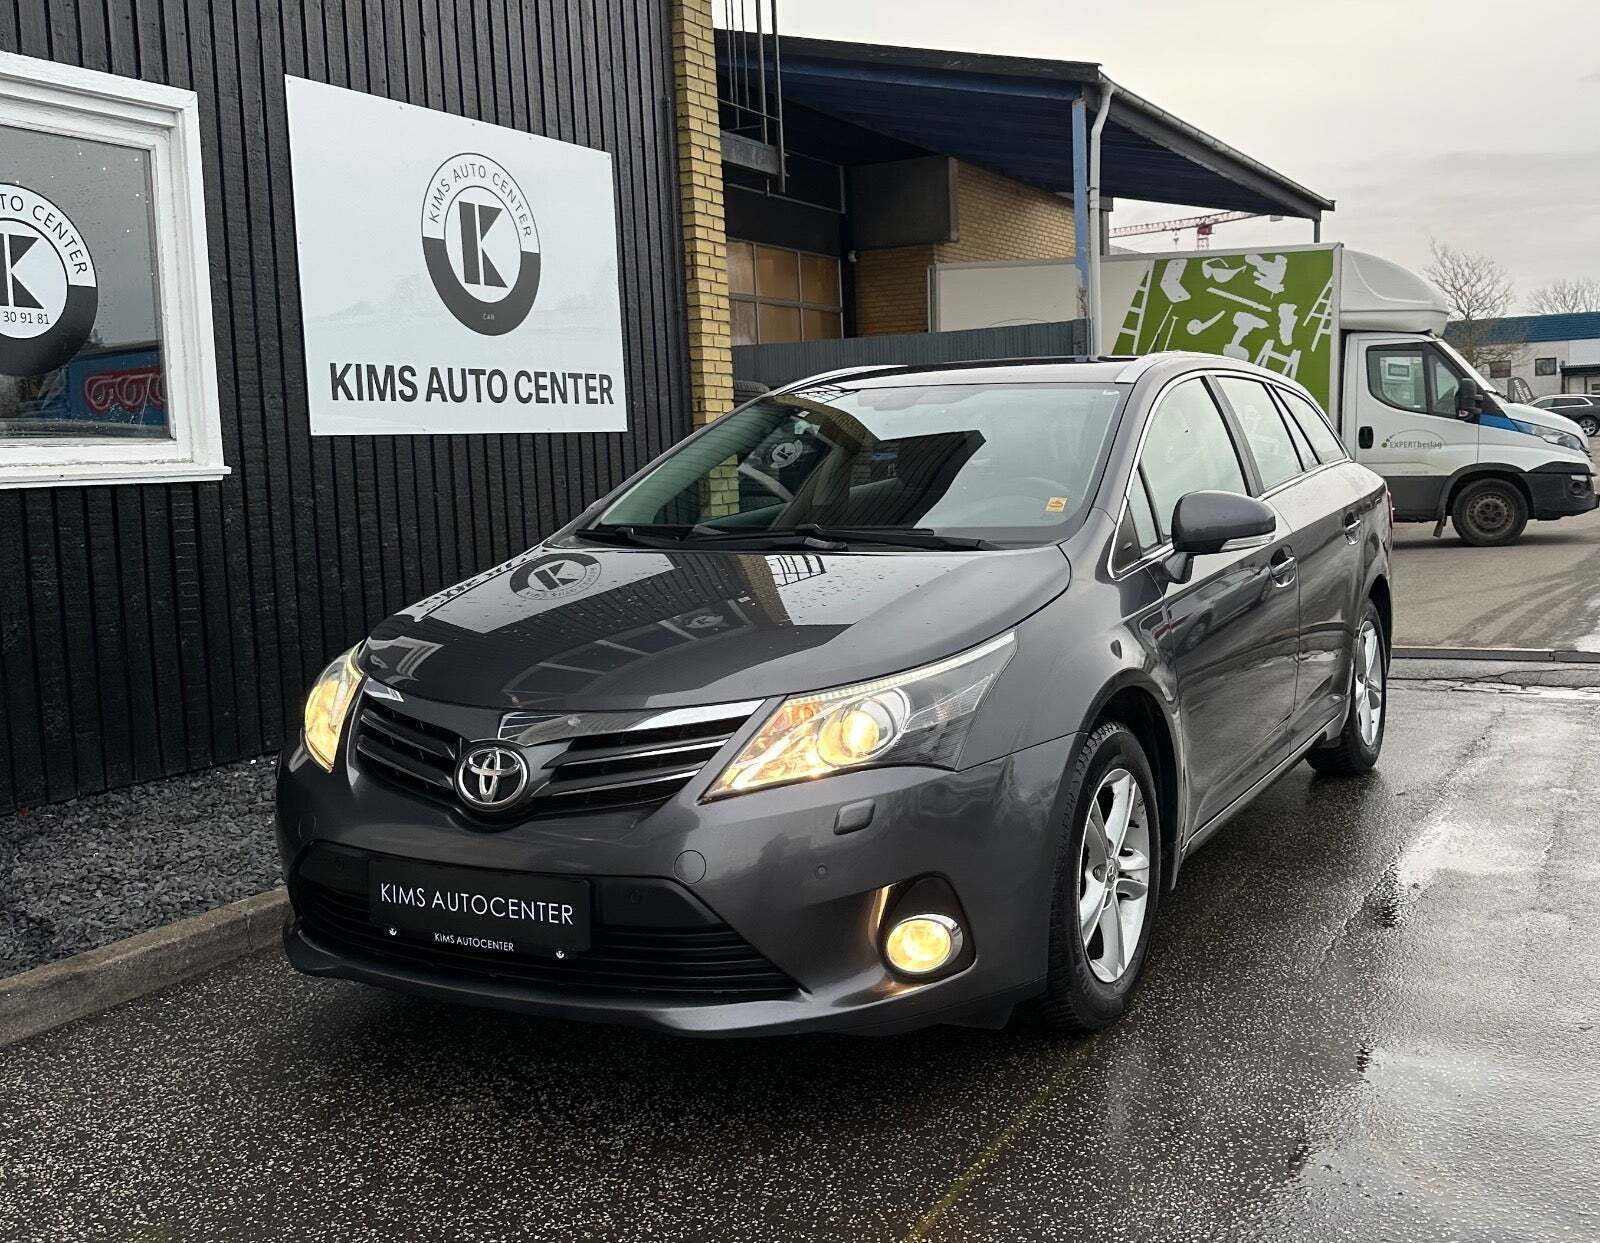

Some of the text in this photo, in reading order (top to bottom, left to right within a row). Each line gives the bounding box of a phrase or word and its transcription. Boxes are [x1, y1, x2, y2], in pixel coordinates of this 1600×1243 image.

[428, 163, 532, 238] KIMS AUTO CENTER
[32, 204, 88, 275] CENTER
[458, 200, 509, 289] K
[3, 311, 51, 325] 30 91 81
[329, 362, 614, 405] KIMS AUTO CENTER
[381, 882, 574, 926] KIMS AUTOCENTER
[434, 932, 515, 952] KIMS AUTOCENTER
